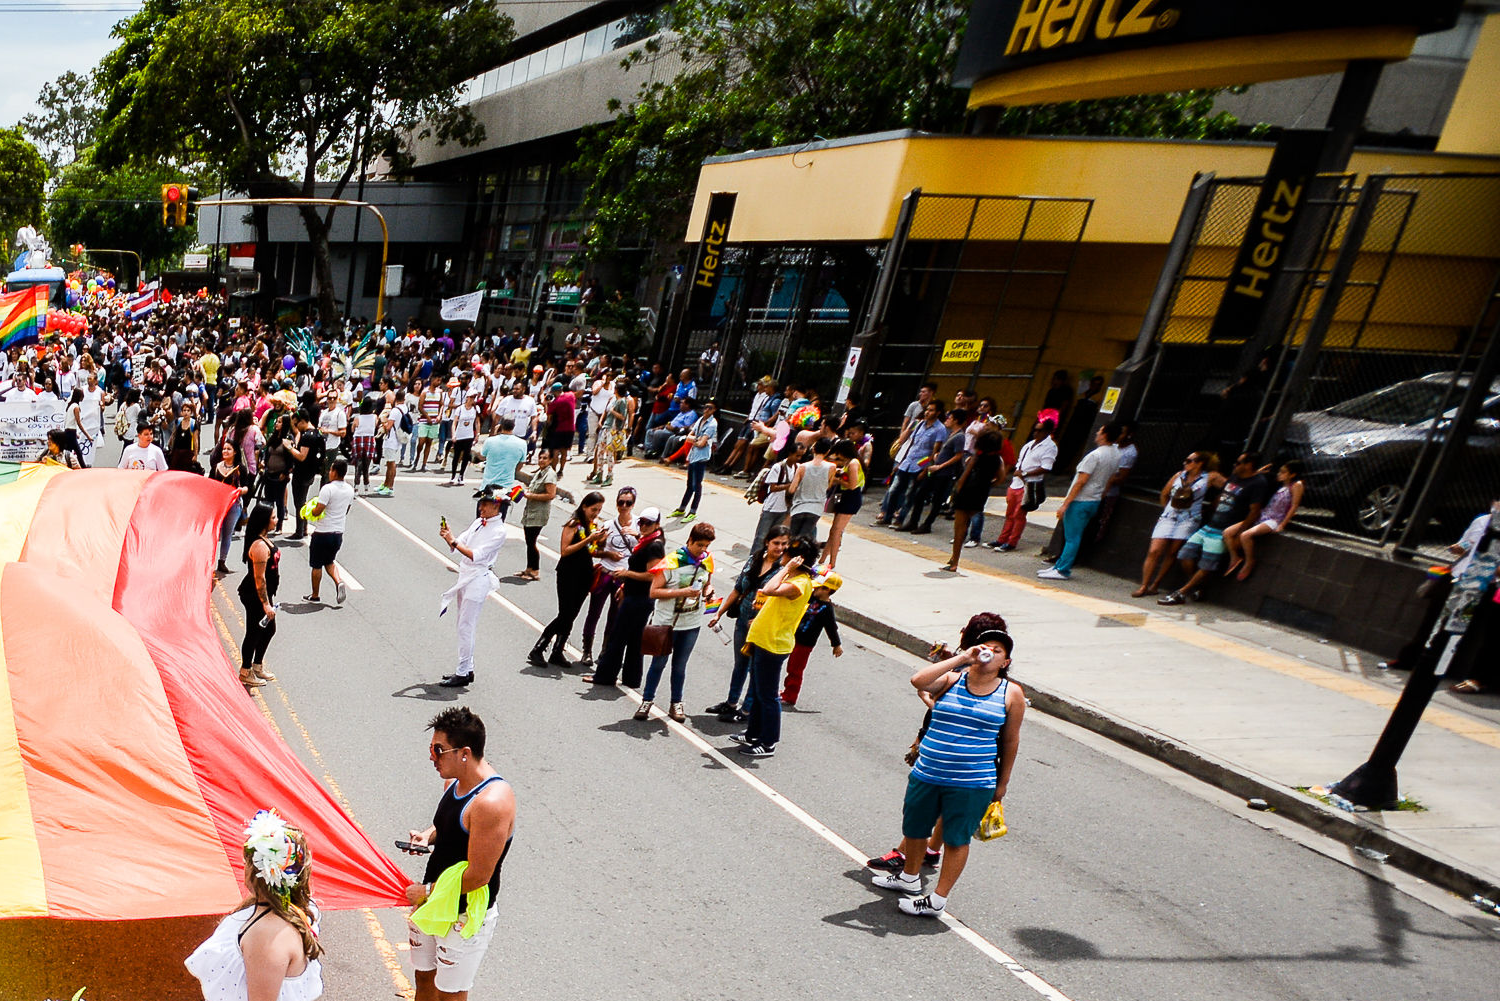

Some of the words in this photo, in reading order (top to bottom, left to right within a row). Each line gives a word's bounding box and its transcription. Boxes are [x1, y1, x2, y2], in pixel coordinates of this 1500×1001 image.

[696, 221, 726, 287] Hertz
[1234, 180, 1301, 298] Hertz
[943, 351, 980, 359] ABIERTO
[951, 342, 975, 350] OPEN
